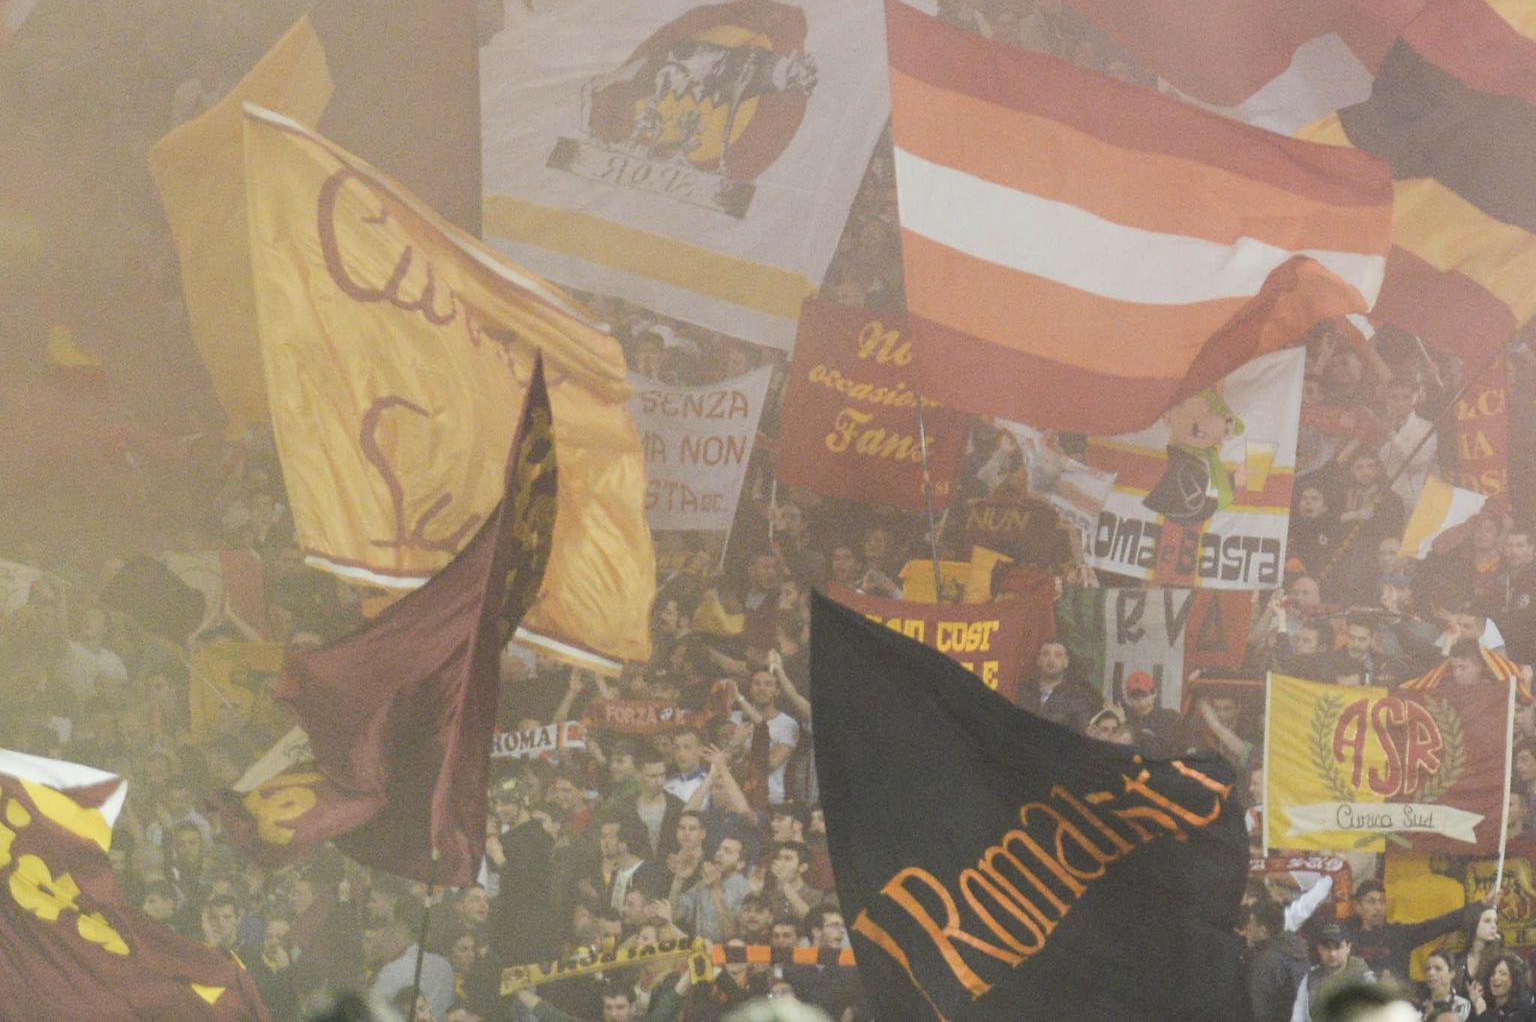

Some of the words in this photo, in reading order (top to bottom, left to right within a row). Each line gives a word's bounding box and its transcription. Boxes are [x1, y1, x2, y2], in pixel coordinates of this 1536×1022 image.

[639, 390, 749, 420] SENZA
[679, 433, 749, 467] NON
[1332, 696, 1444, 797] ASR
[1402, 805, 1436, 829] Sud
